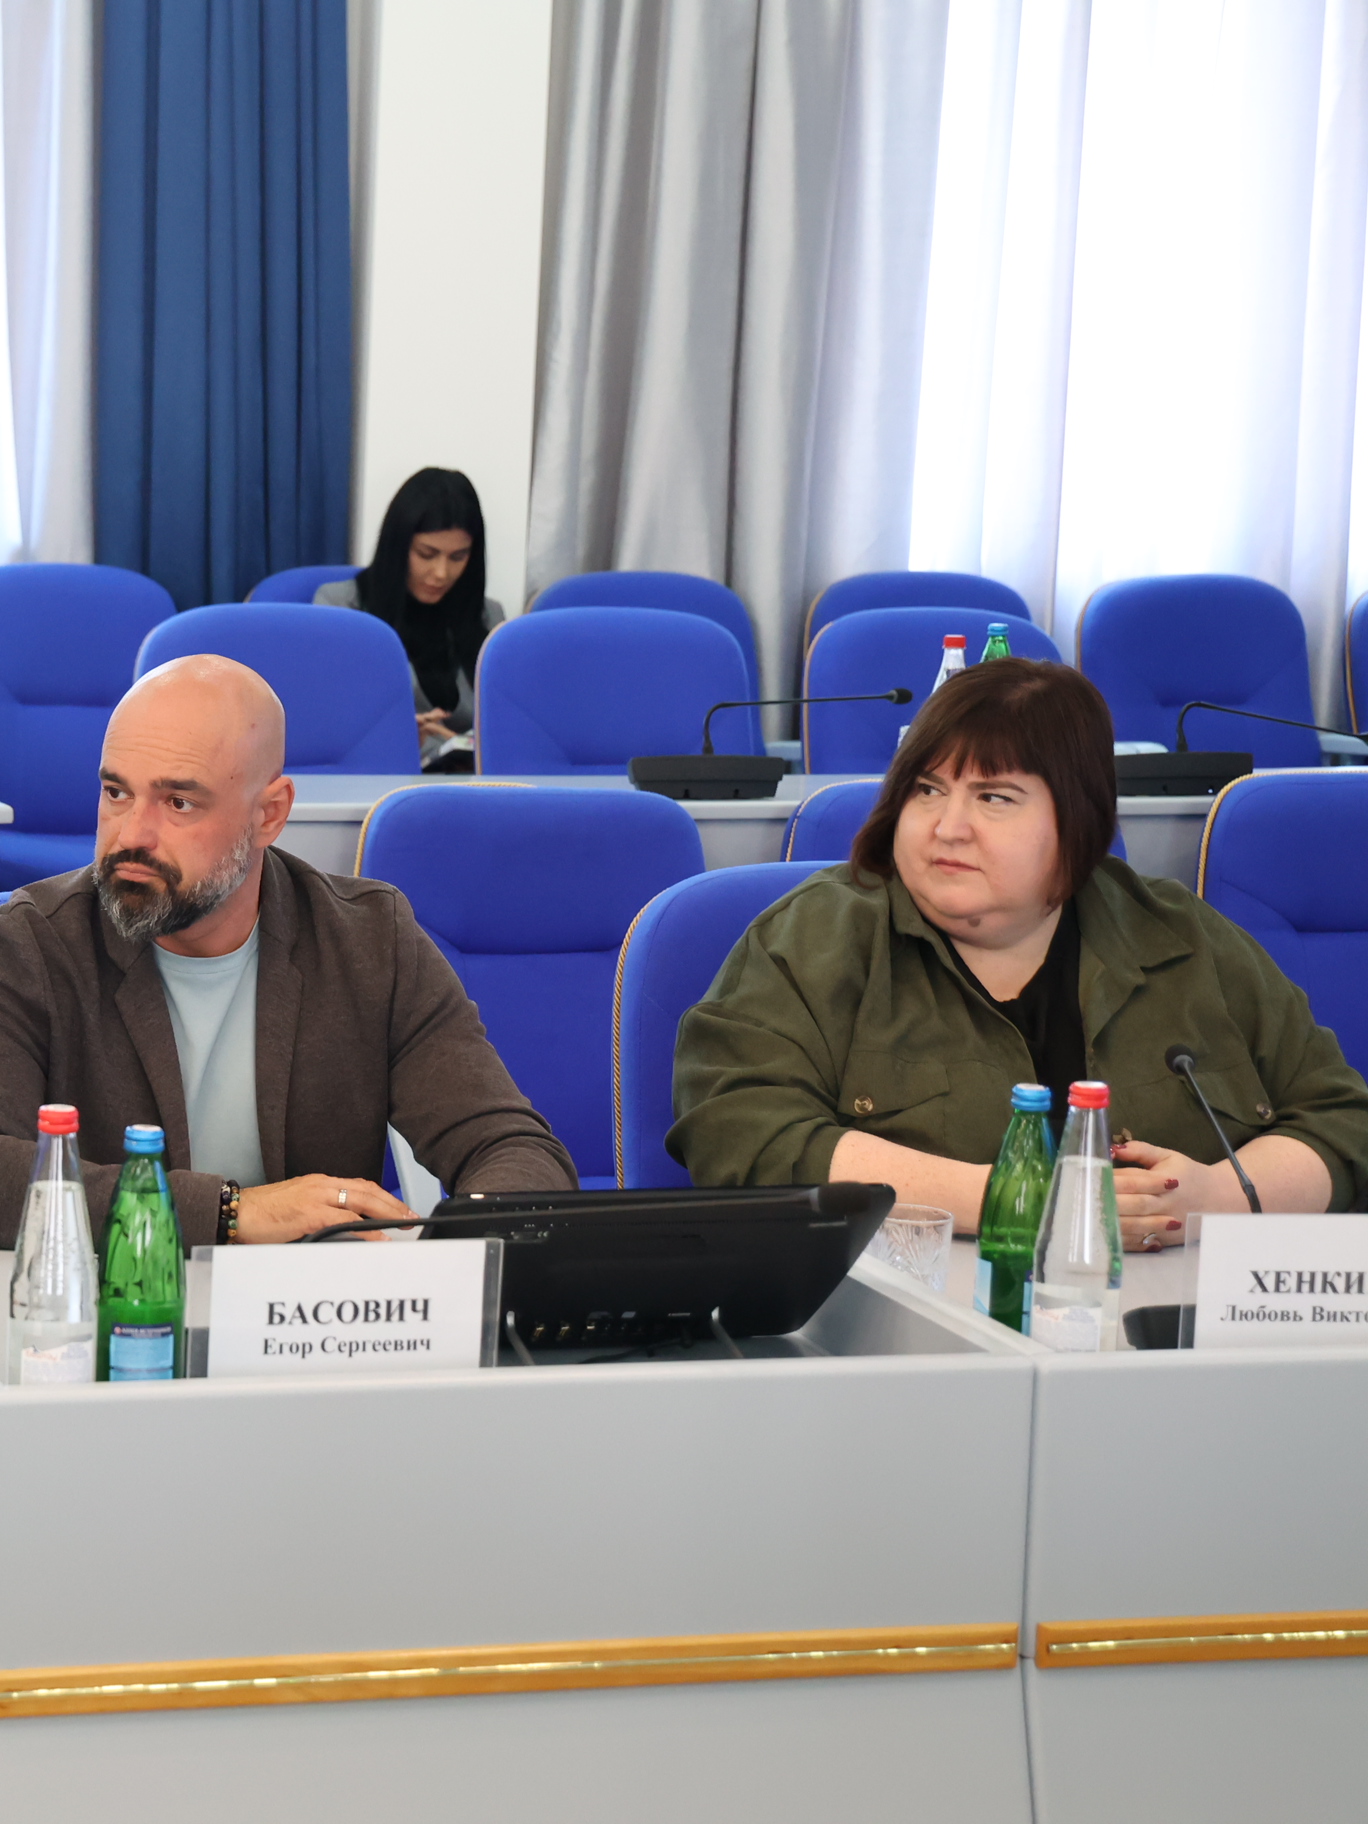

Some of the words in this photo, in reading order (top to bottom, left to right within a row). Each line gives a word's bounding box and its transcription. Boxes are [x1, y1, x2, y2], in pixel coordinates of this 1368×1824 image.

[266, 1298, 431, 1325] БАСОВИЧ
[1220, 1304, 1304, 1322] Любовь
[263, 1337, 314, 1359] Егор
[320, 1335, 431, 1359] Сергеевич
